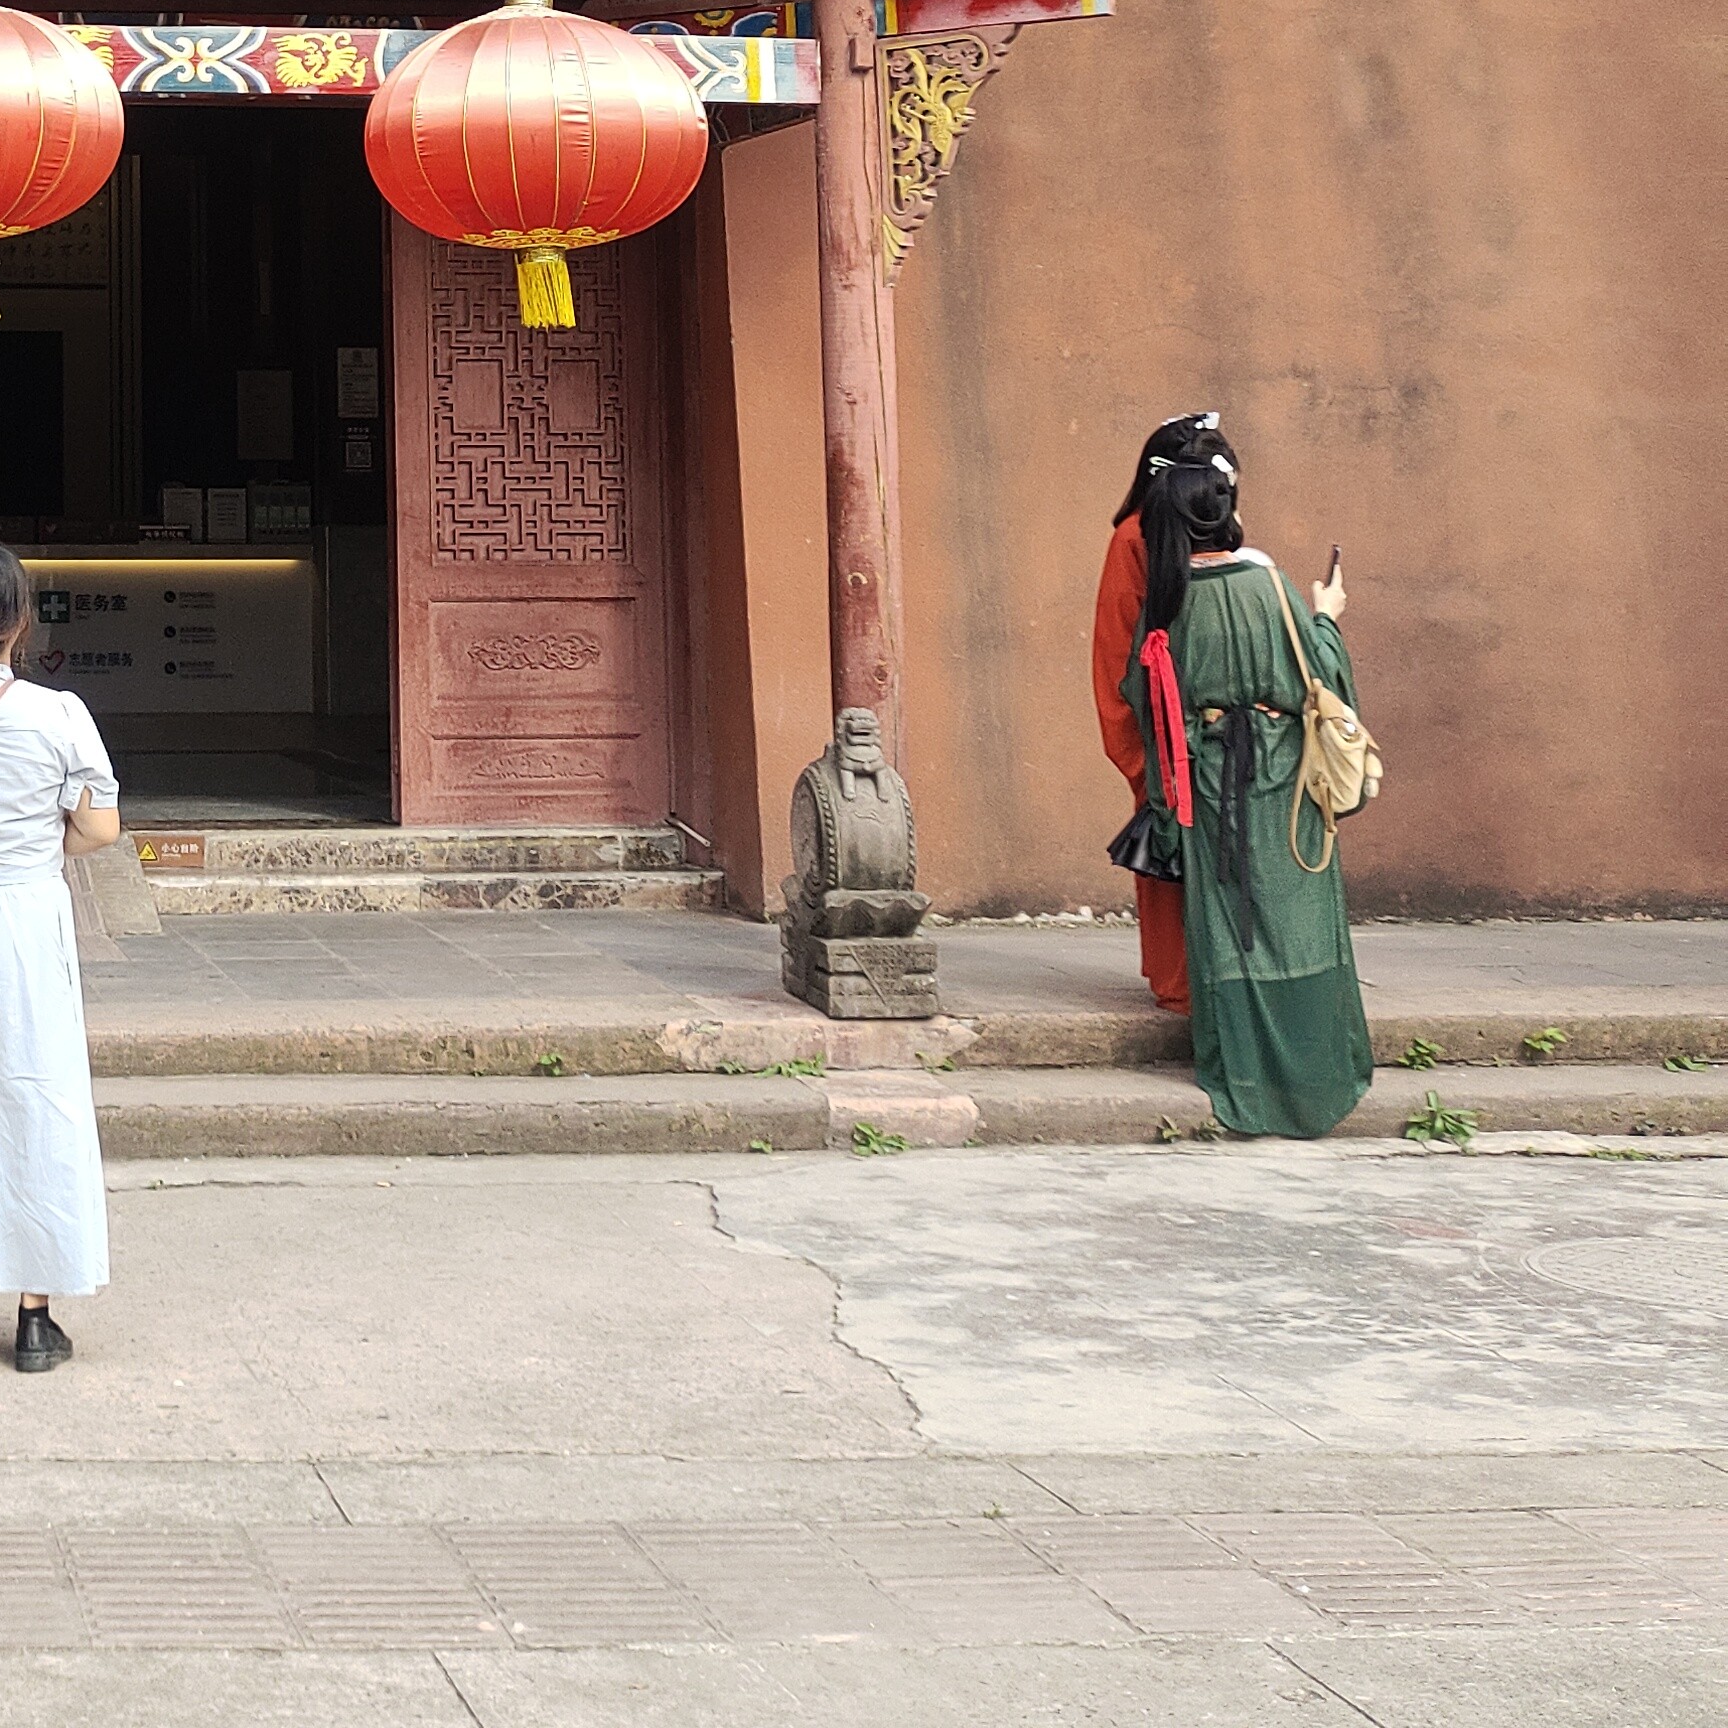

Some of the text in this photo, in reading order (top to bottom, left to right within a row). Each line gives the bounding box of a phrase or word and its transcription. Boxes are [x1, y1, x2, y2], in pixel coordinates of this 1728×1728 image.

[75, 594, 128, 612] 医务室
[68, 652, 134, 667] 志愿者服务
